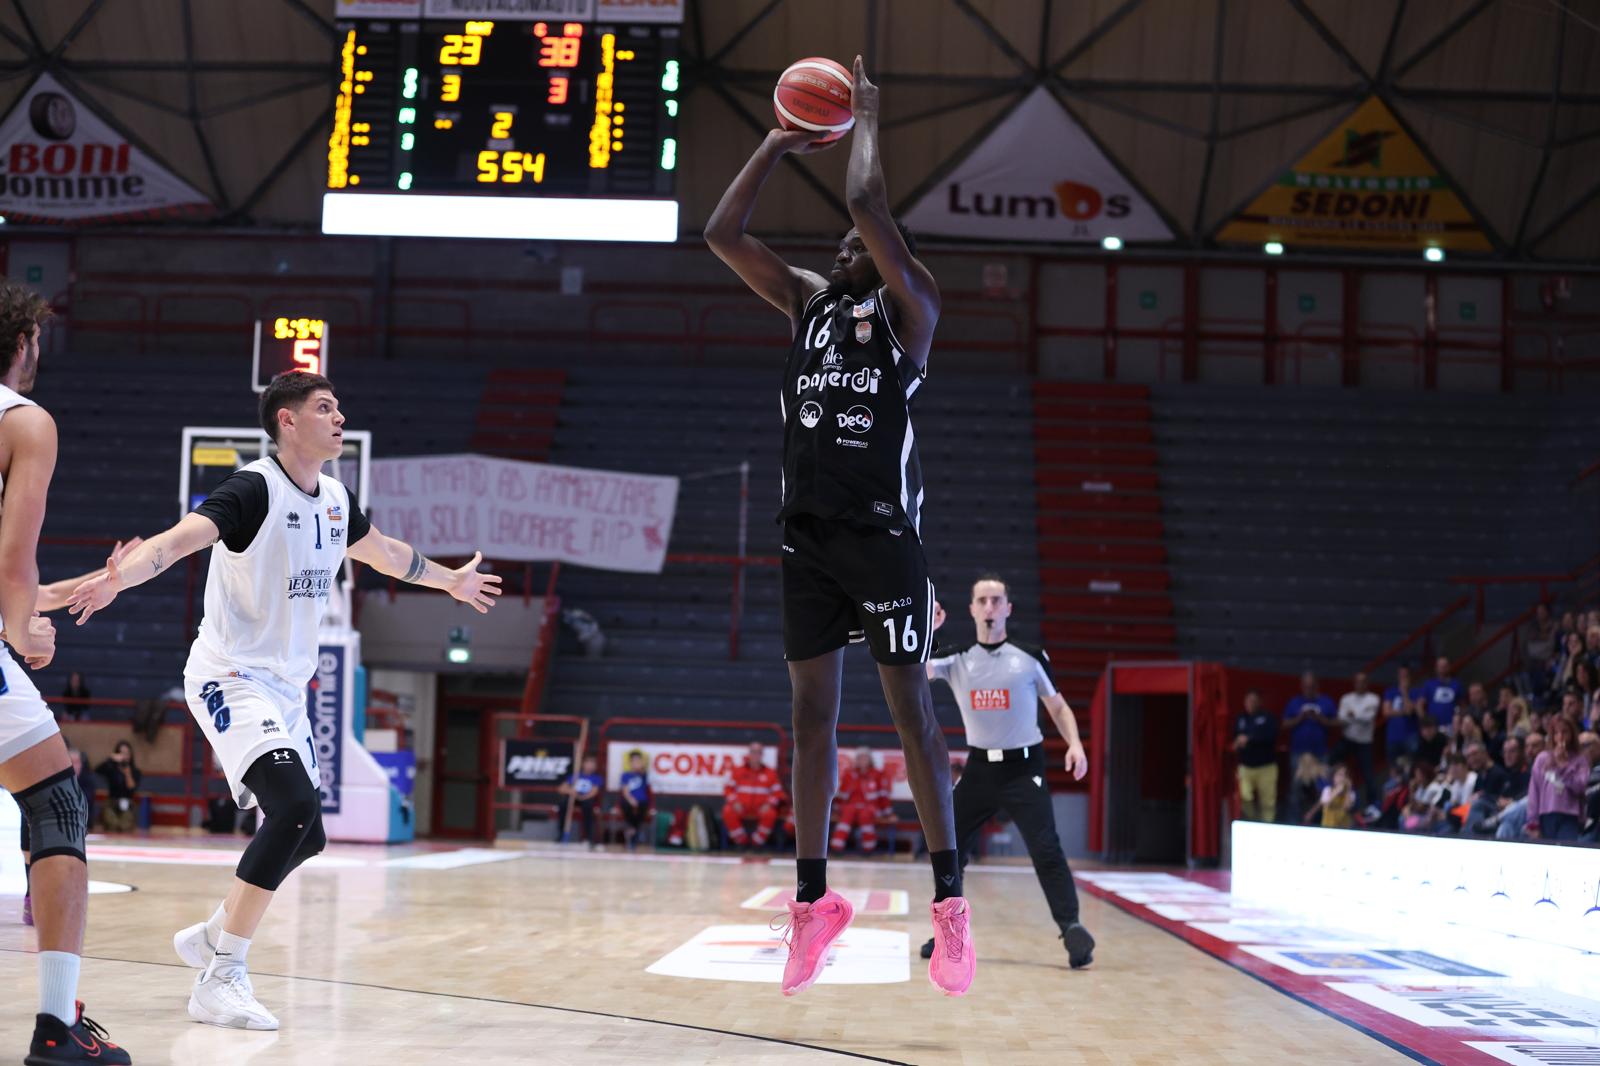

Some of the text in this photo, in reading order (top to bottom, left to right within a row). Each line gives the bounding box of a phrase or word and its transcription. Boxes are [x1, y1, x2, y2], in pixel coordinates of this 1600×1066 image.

[439, 34, 483, 66] 23
[538, 36, 581, 67] 38
[441, 74, 461, 102] 3
[547, 77, 568, 105] 3
[491, 112, 513, 139] 2
[949, 179, 1131, 221] Lumos
[1290, 191, 1431, 219] SEDONI
[805, 316, 832, 350] 16
[294, 340, 320, 374] 5
[883, 614, 918, 653] 16
